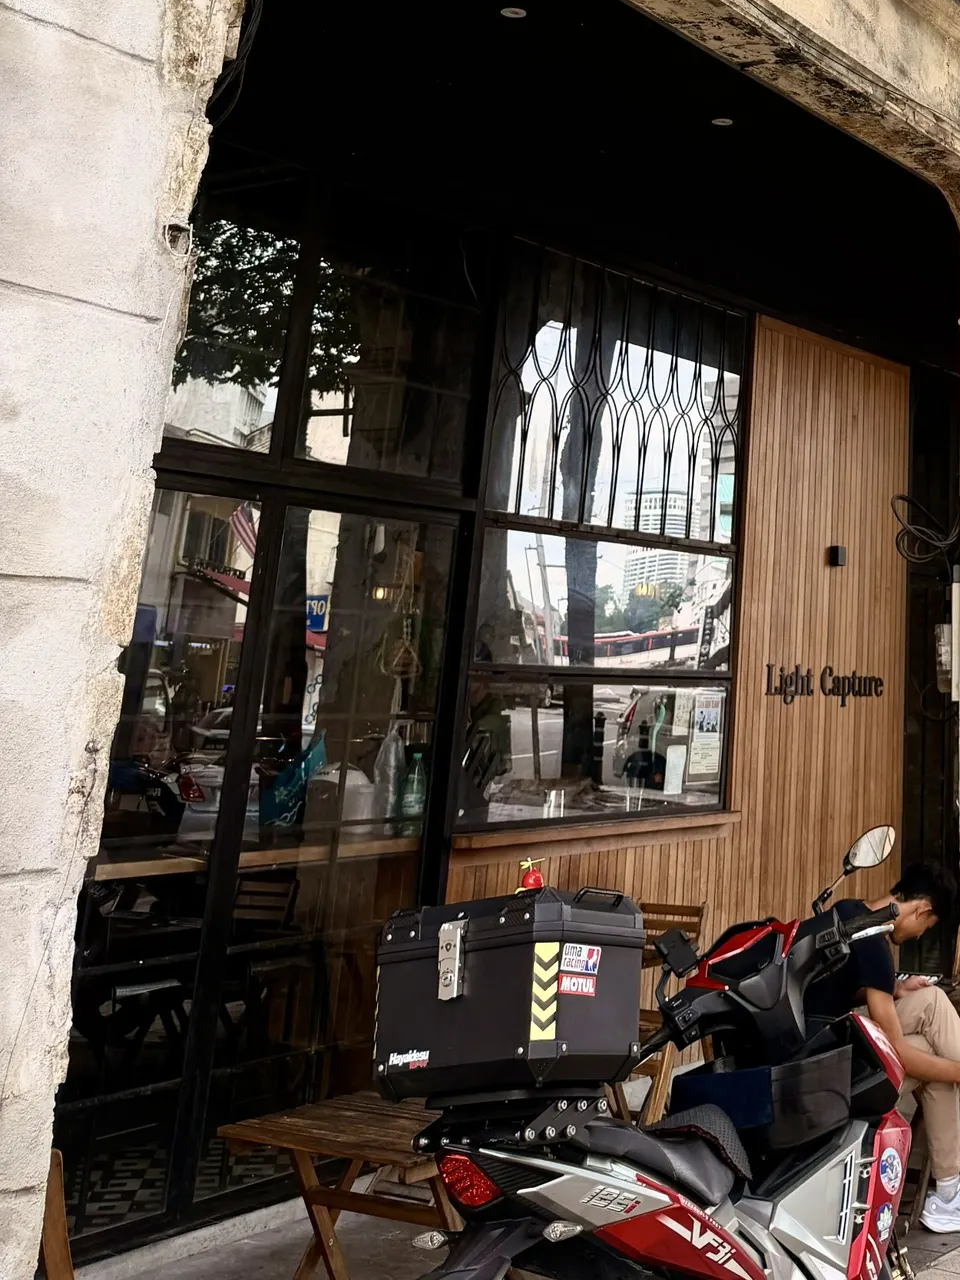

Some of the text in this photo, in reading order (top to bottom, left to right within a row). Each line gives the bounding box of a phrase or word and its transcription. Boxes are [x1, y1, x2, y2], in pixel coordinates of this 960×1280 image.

[765, 663, 884, 707] Light Capture
[565, 945, 583, 957] uma
[563, 957, 586, 971] racing
[560, 976, 595, 993] MOTUL
[389, 1049, 430, 1066] Hayaidesu
[688, 1213, 737, 1264] VF3i
